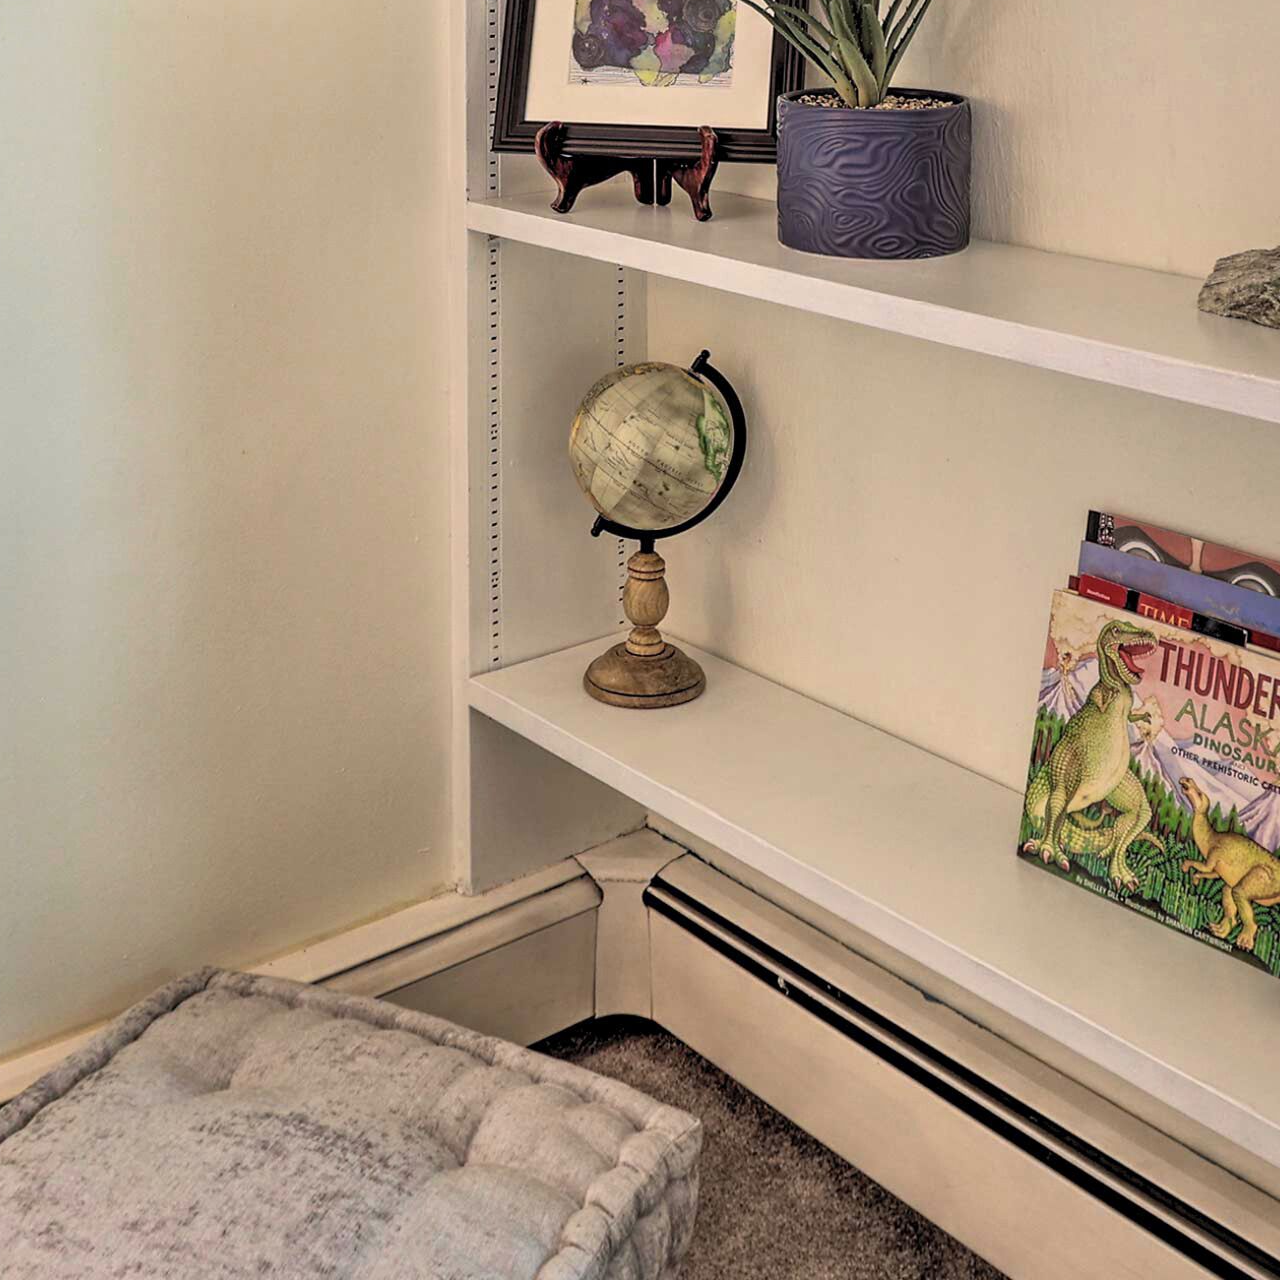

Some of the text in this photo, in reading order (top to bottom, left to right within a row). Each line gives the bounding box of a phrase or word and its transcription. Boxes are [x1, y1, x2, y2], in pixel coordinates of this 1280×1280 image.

[1141, 603, 1192, 628] TIME
[1171, 746, 1200, 765] OTHER
[1201, 757, 1259, 788] PREHISTORIC
[1083, 878, 1107, 895] SHELLEY
[1165, 916, 1193, 936] SHANNON
[1193, 928, 1234, 953] CARTWRIGHT
